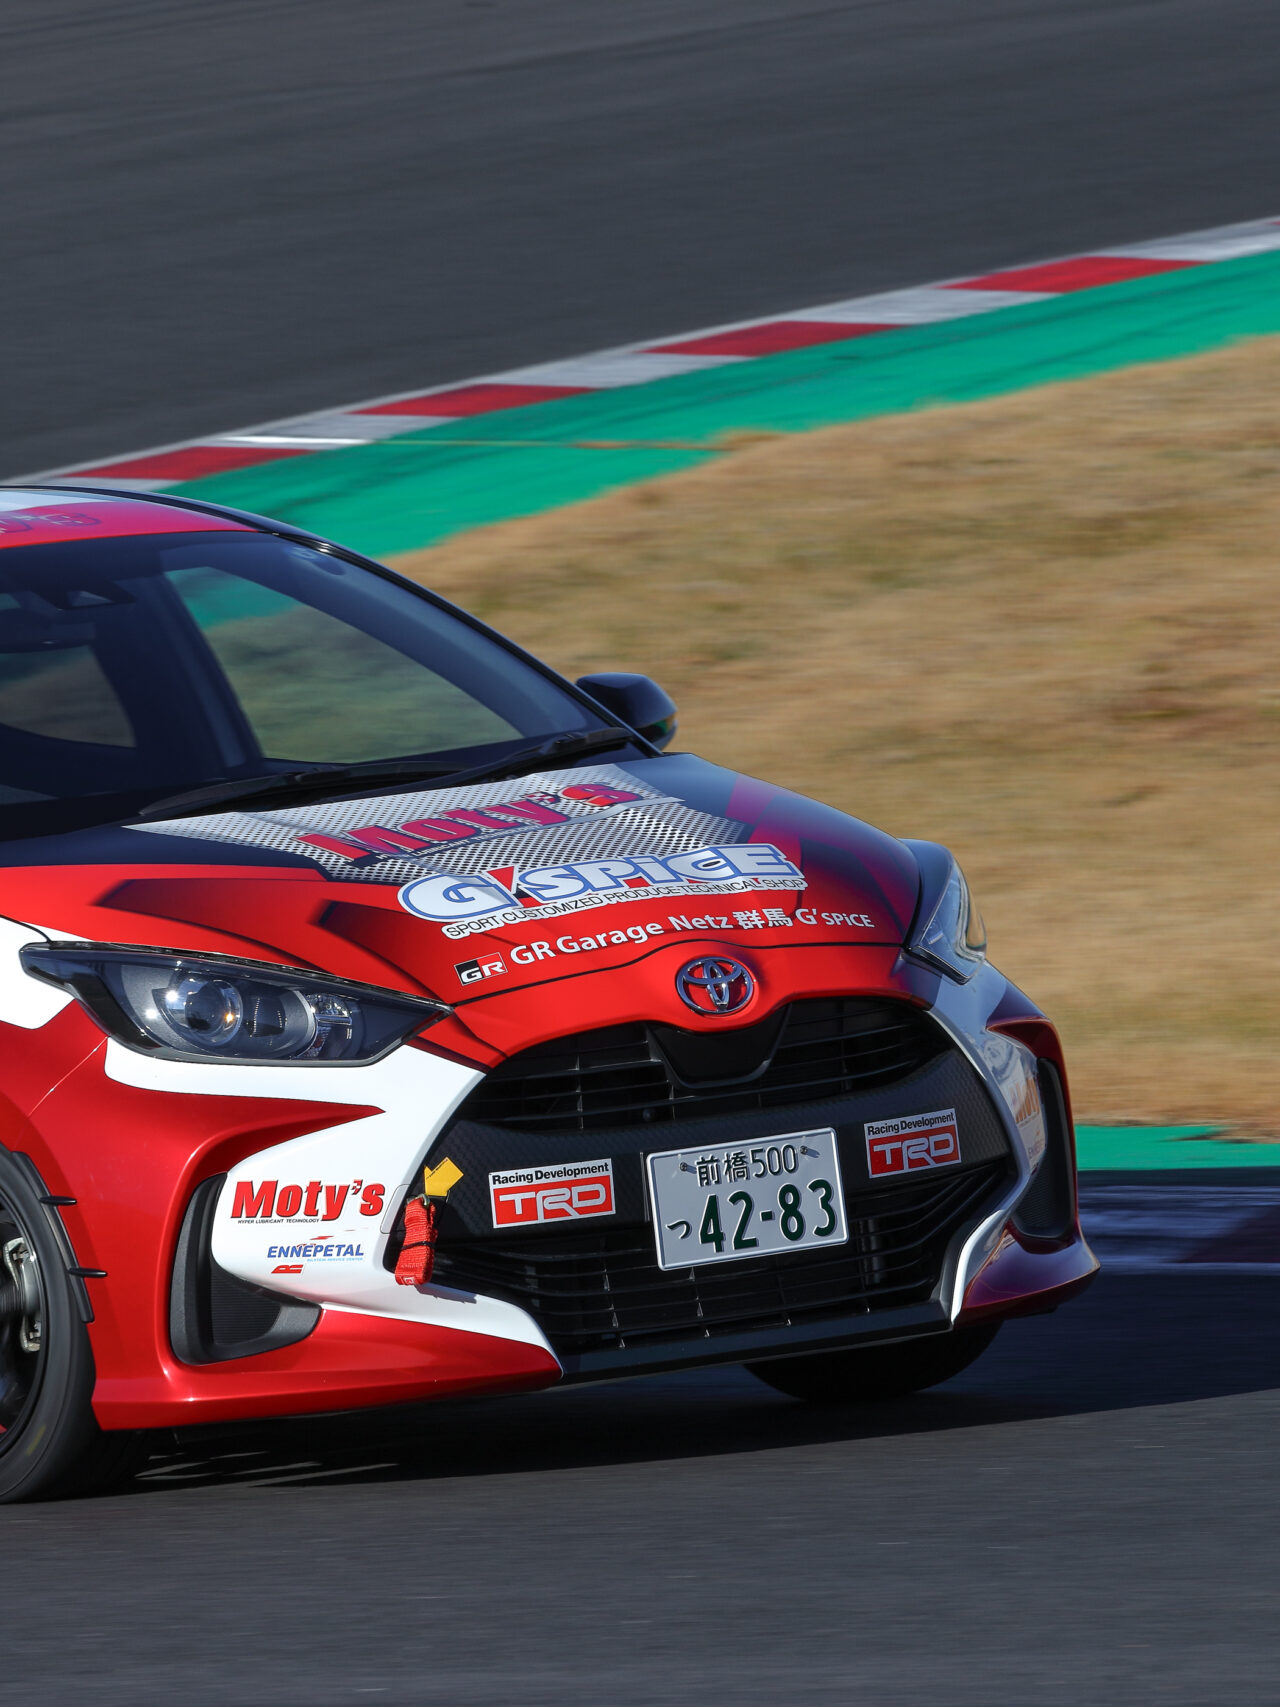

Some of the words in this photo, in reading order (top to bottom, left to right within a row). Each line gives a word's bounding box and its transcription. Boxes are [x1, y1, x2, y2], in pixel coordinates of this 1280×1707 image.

[294, 782, 643, 864] Moty's
[446, 915, 502, 937] SPORT
[502, 896, 604, 922] CUSTOMIZED
[763, 878, 805, 890] SHOP
[460, 960, 506, 984] GR
[510, 940, 556, 965] GR
[556, 922, 665, 954] Garage
[668, 913, 734, 931] Netz
[732, 907, 794, 930] 群馬
[867, 1122, 900, 1137] Racing
[900, 1111, 955, 1131] Development
[873, 1132, 955, 1171] TRD
[491, 1172, 534, 1186] Racing
[534, 1162, 610, 1181] Development
[230, 1178, 386, 1222] Moty's
[499, 1183, 607, 1223] TRD
[665, 1219, 692, 1240] つ
[698, 1178, 838, 1254] 42-83
[267, 1243, 364, 1259] ENNEPETAL
